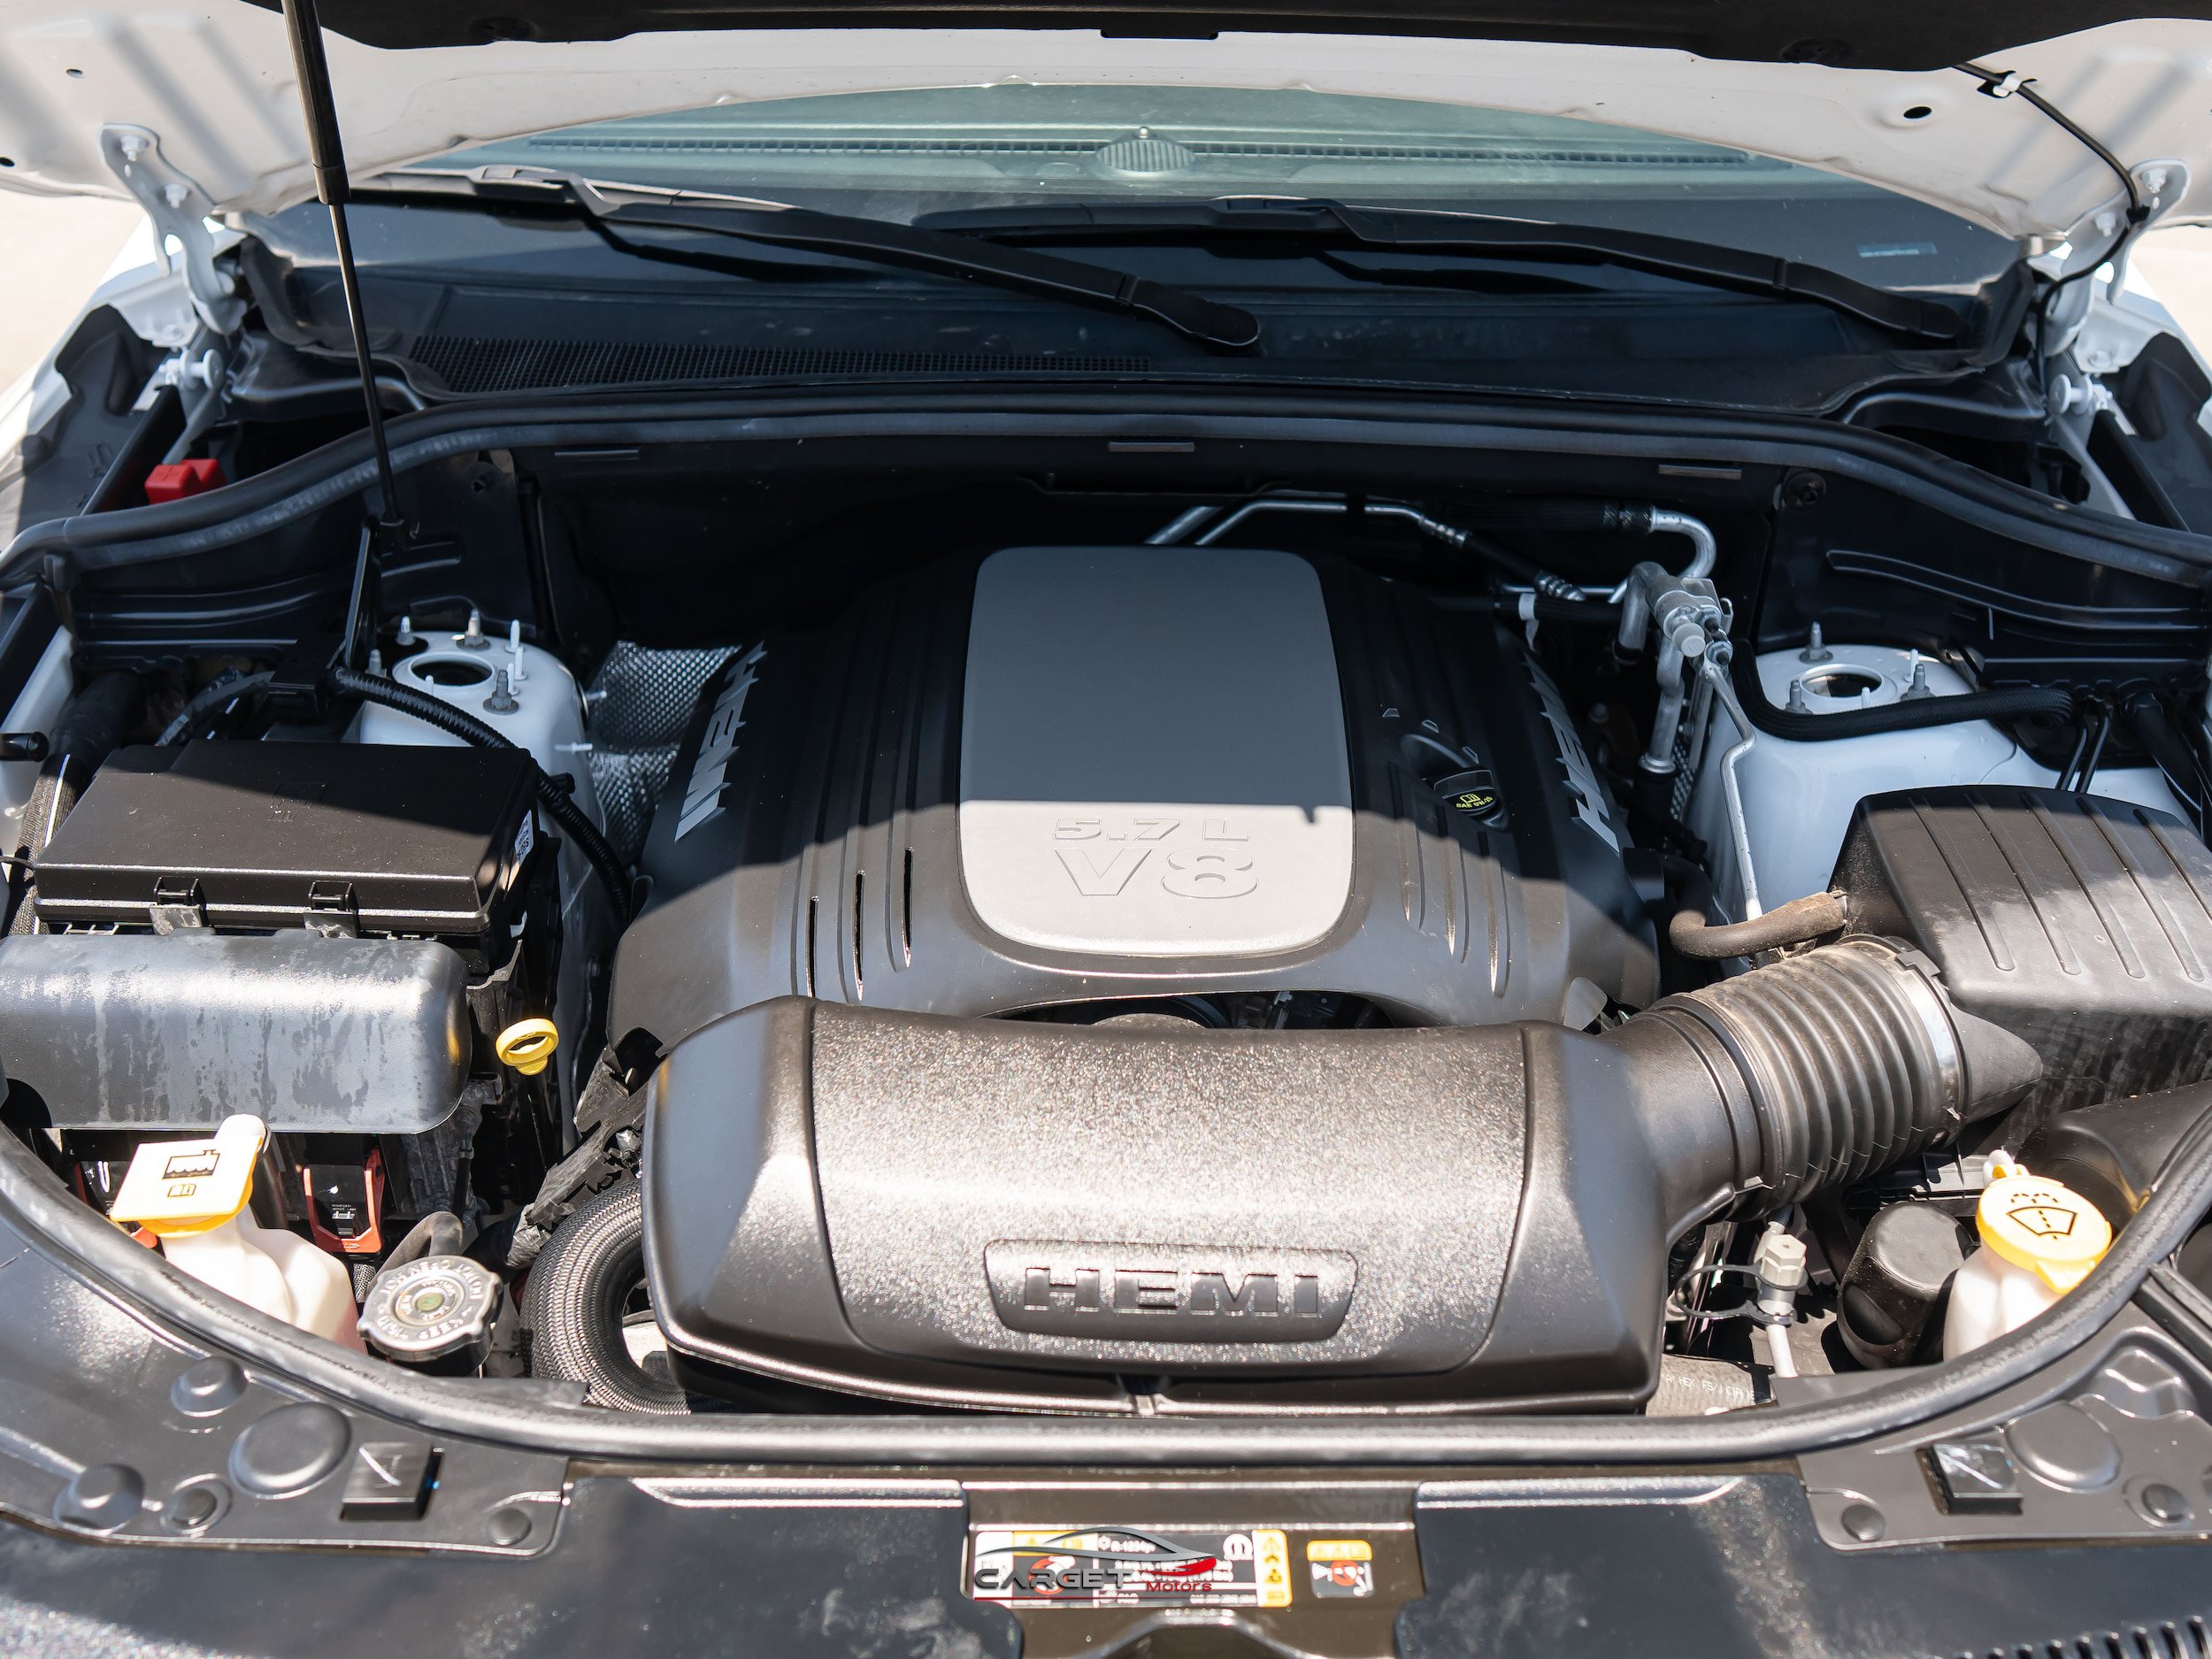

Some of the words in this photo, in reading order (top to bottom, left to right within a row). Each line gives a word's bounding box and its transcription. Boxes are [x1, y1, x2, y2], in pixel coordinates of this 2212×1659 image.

[675, 640, 768, 841] HEMI
[1054, 847, 1258, 899] V8
[1024, 1267, 1318, 1318] HEMI
